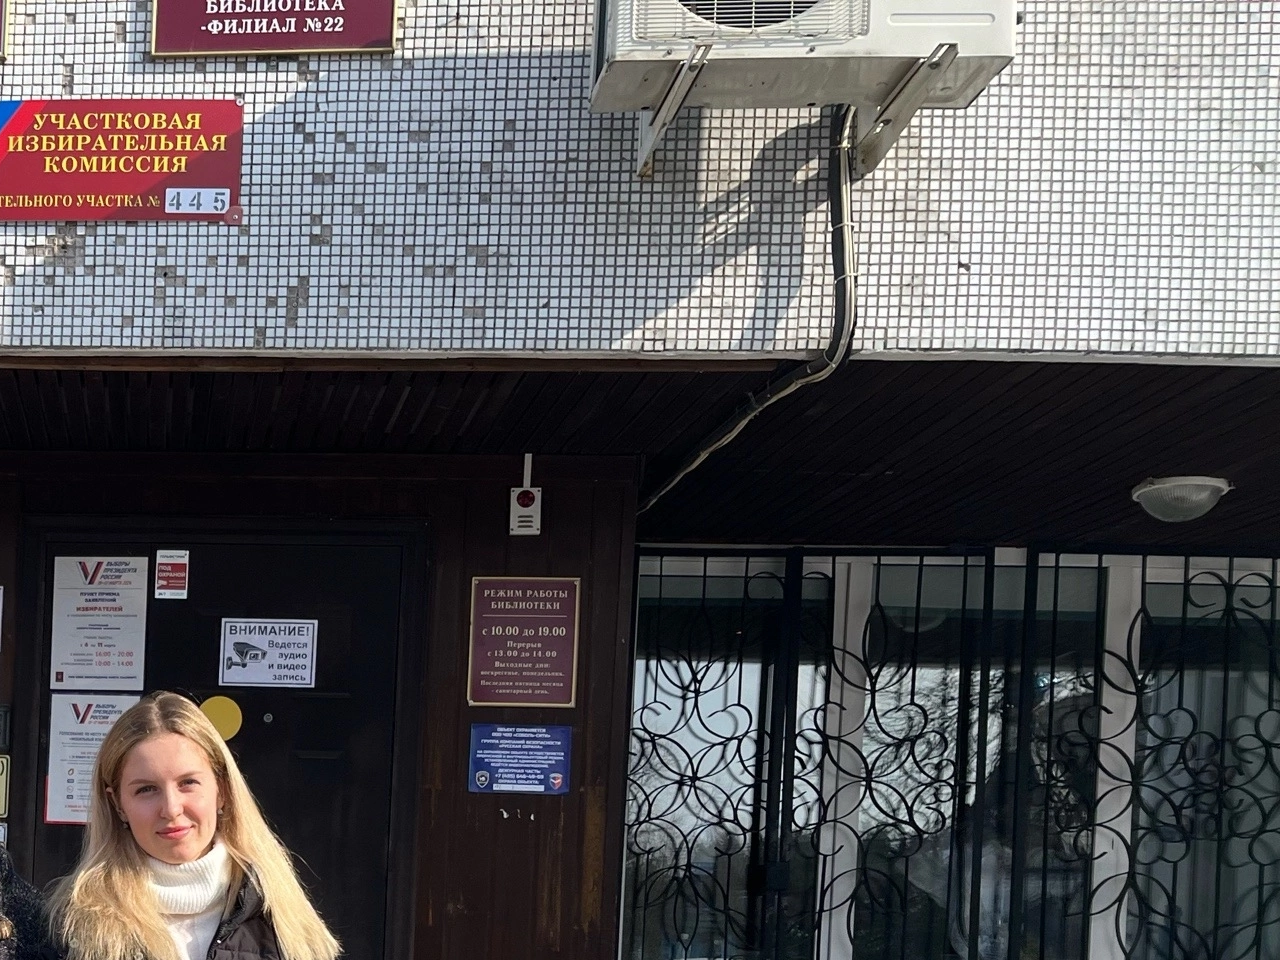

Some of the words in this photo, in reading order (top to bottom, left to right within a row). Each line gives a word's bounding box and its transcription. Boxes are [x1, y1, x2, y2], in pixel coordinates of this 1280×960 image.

[206, 0, 345, 14] БИБЛИОТЕКА
[303, 17, 344, 33] №22
[33, 112, 202, 131] УЧАСТКОВАЯ
[7, 134, 228, 152] ИЗБИРАТЕЛЬНАЯ
[43, 156, 188, 173] КОМИССИЯ
[76, 194, 143, 208] УЧАСТКА
[146, 195, 160, 208] №
[484, 589, 522, 597] РЕЖИМ
[526, 590, 568, 598] РАБОТЫ
[491, 601, 560, 610] БИБЛИОТЕКИ
[229, 625, 310, 636] ВНИМАНИЕ!
[482, 628, 488, 636] с
[491, 626, 519, 636] 10.00
[522, 628, 535, 637] до
[538, 626, 566, 637] 19.00
[268, 640, 308, 650] Ведется
[507, 641, 542, 649] Перерыв
[278, 652, 308, 661] аудио
